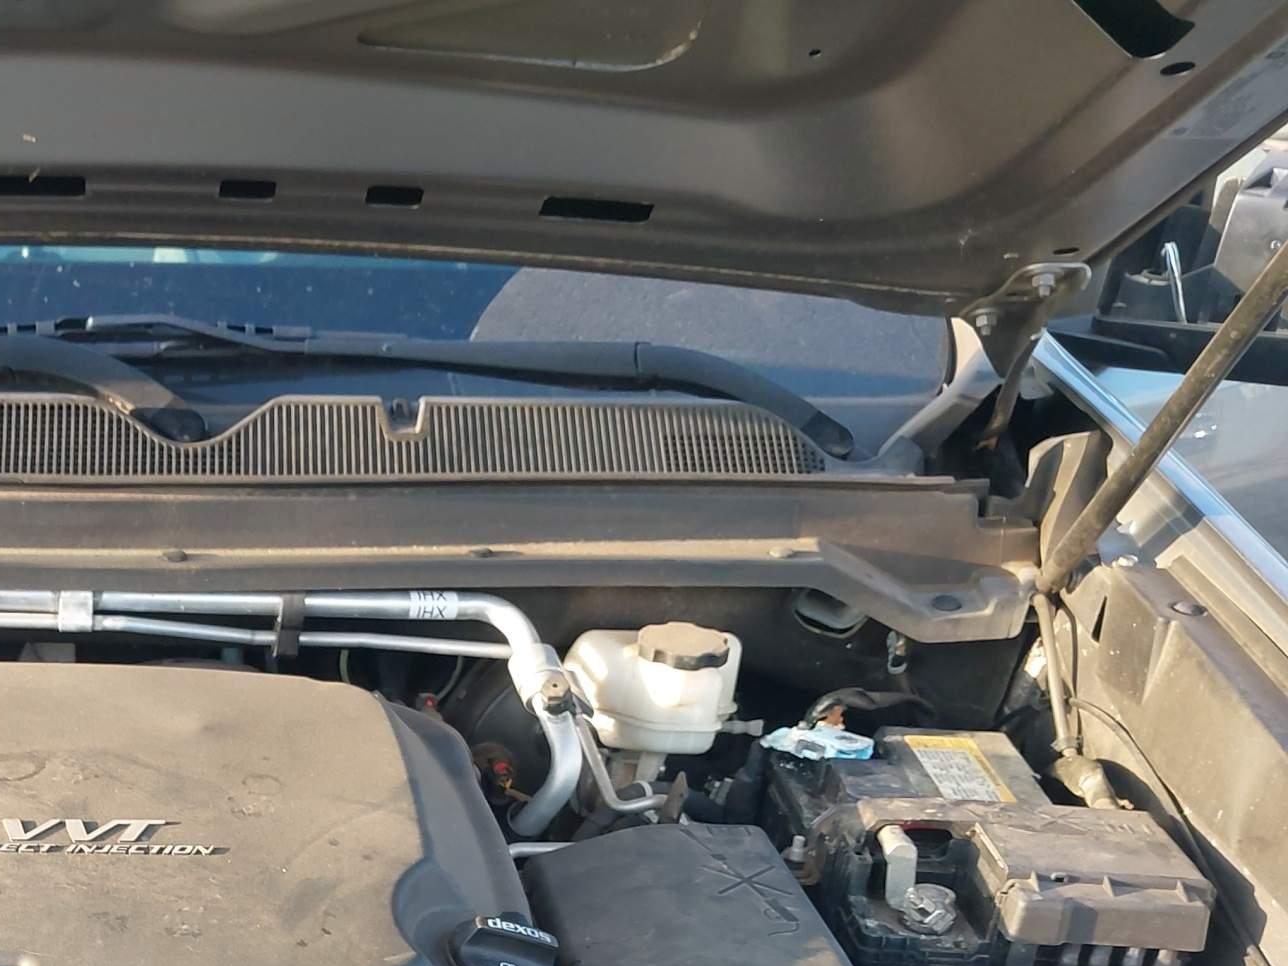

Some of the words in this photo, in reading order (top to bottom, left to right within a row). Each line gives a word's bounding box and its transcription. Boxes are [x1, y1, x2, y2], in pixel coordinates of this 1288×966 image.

[1, 817, 168, 843] VVT
[65, 843, 217, 856] INJECTION
[487, 917, 552, 943] dexos
